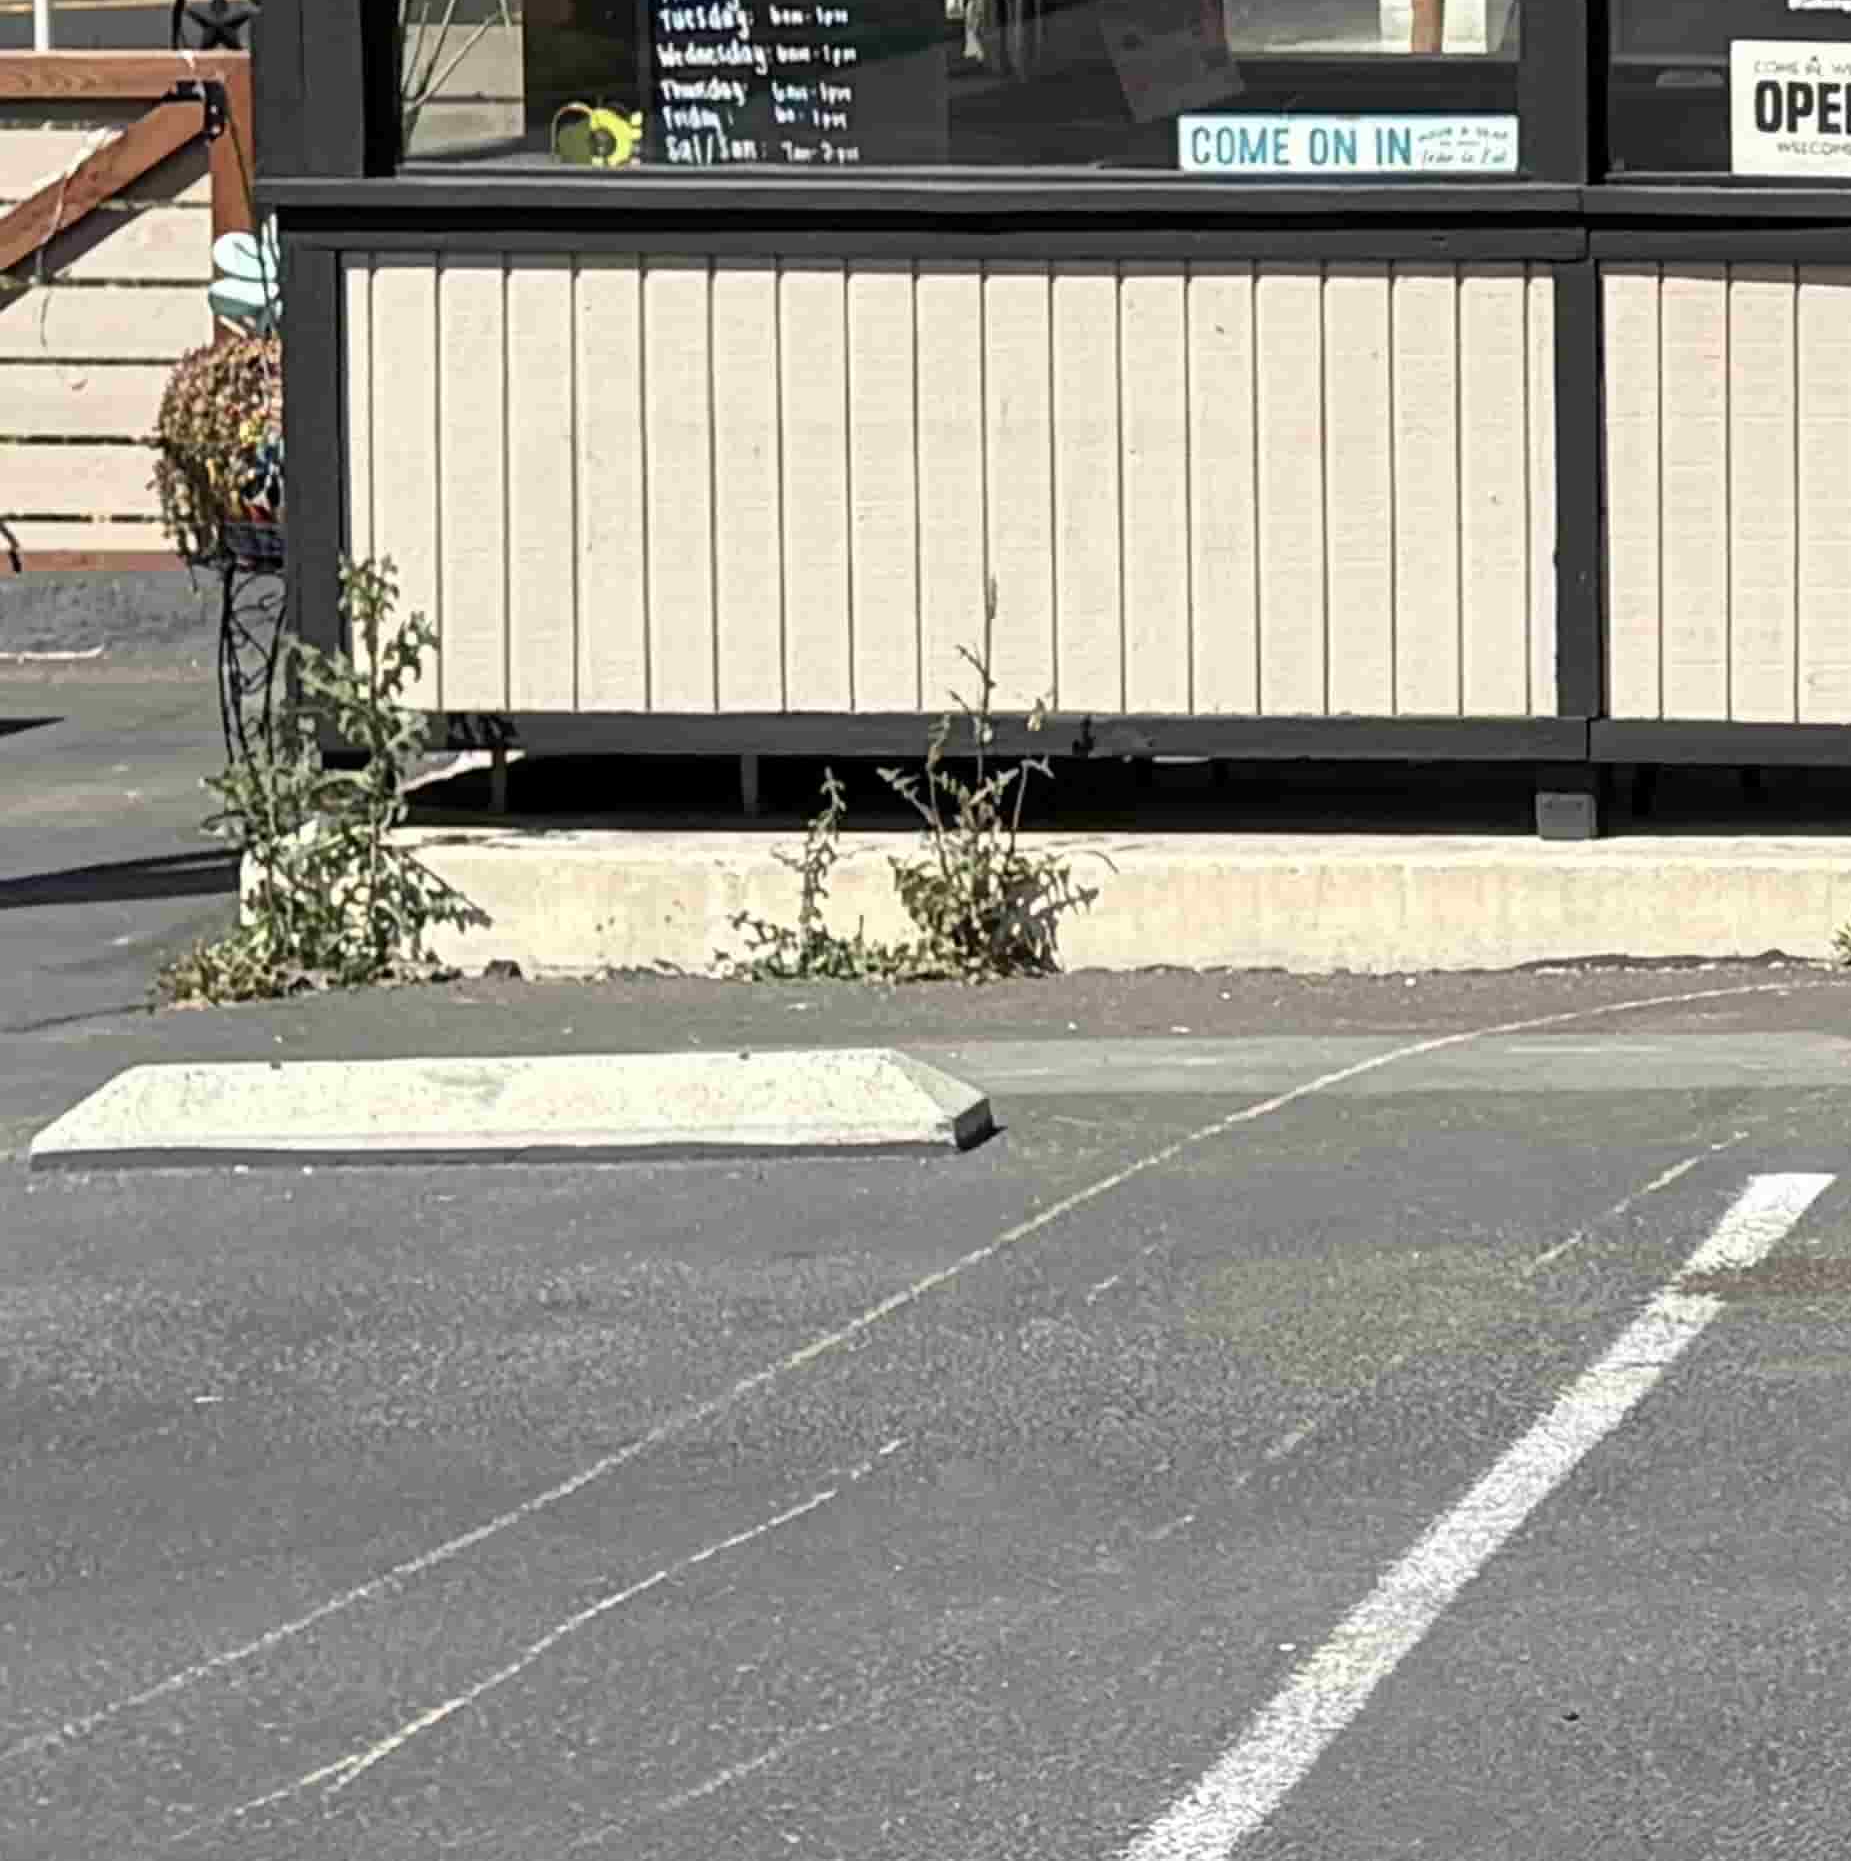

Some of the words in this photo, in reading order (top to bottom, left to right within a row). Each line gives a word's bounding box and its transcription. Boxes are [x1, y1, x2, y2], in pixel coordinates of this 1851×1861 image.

[1191, 125, 1290, 165] COME
[1309, 127, 1357, 165] ON
[1375, 126, 1411, 165] IN
